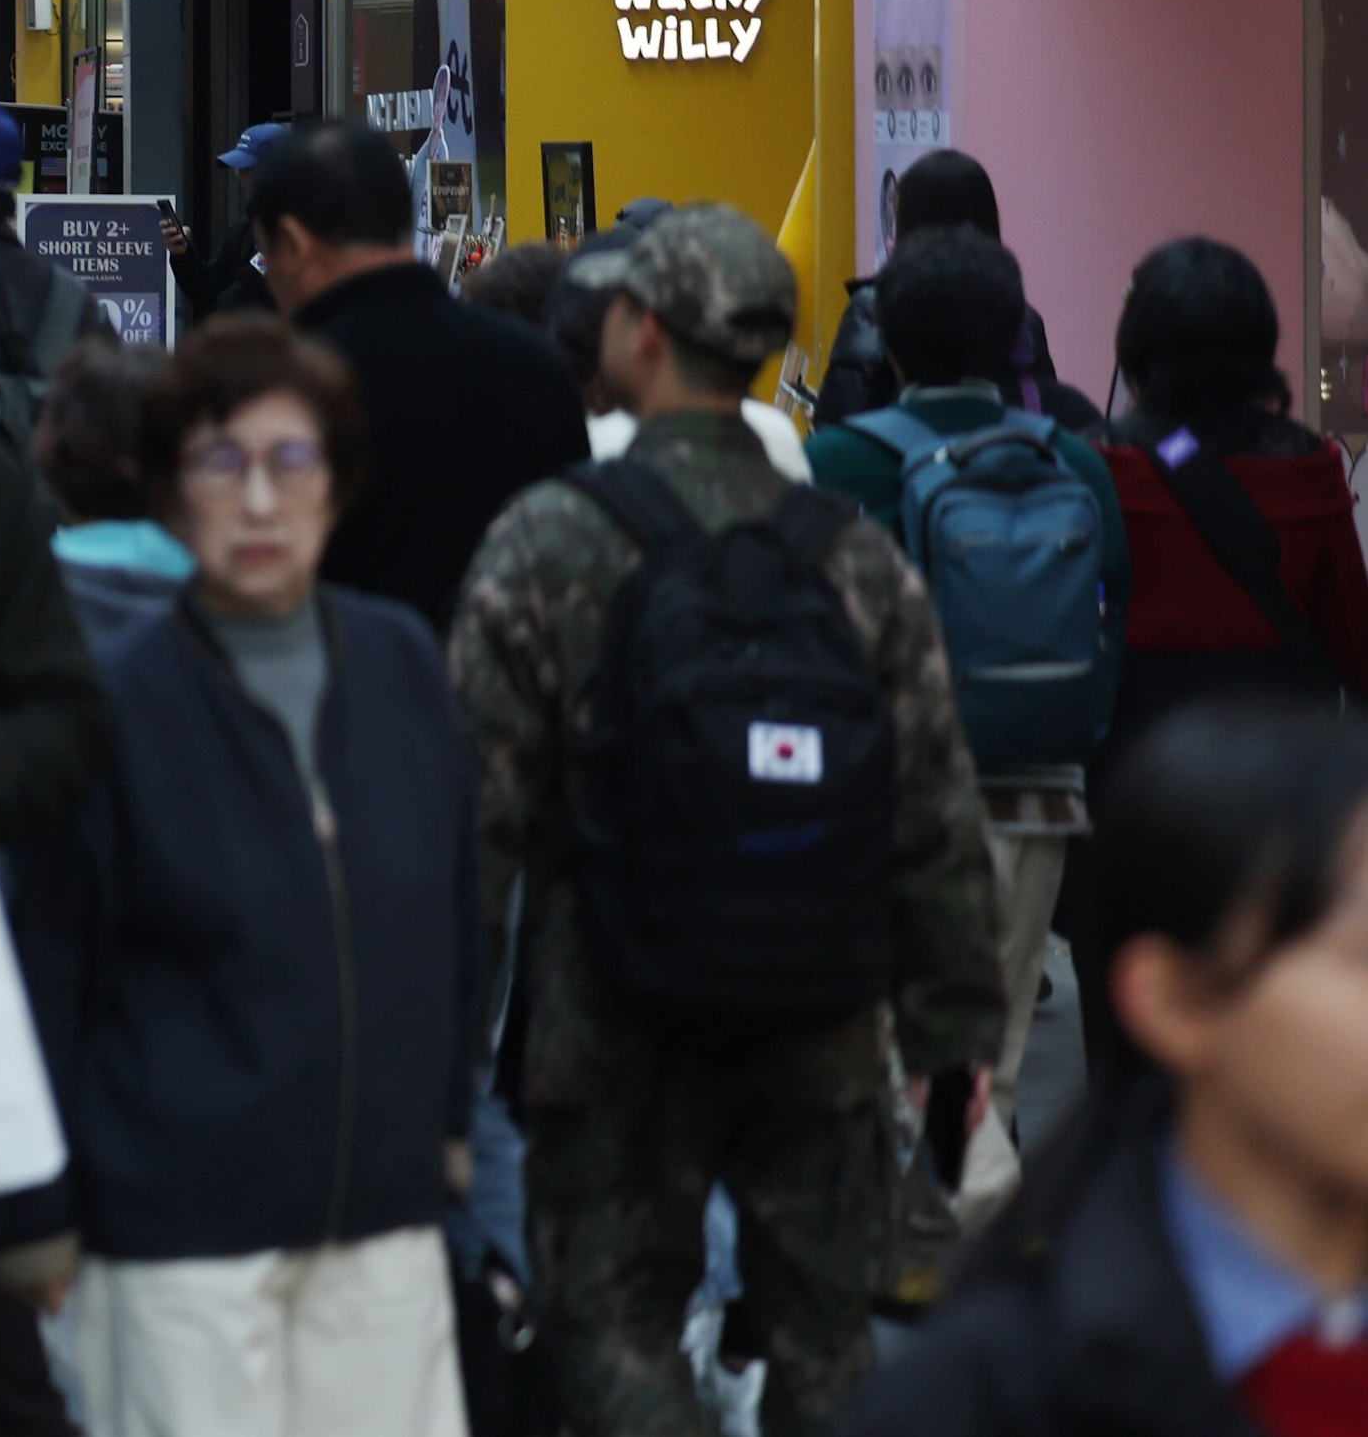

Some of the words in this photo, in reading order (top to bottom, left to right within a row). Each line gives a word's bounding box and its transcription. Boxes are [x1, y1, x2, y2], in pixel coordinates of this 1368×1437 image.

[62, 220, 101, 238] BUY
[38, 241, 93, 256] SHORT
[96, 241, 153, 256] SLEEVE
[72, 257, 119, 273] ITEMS
[123, 329, 152, 344] OFF
